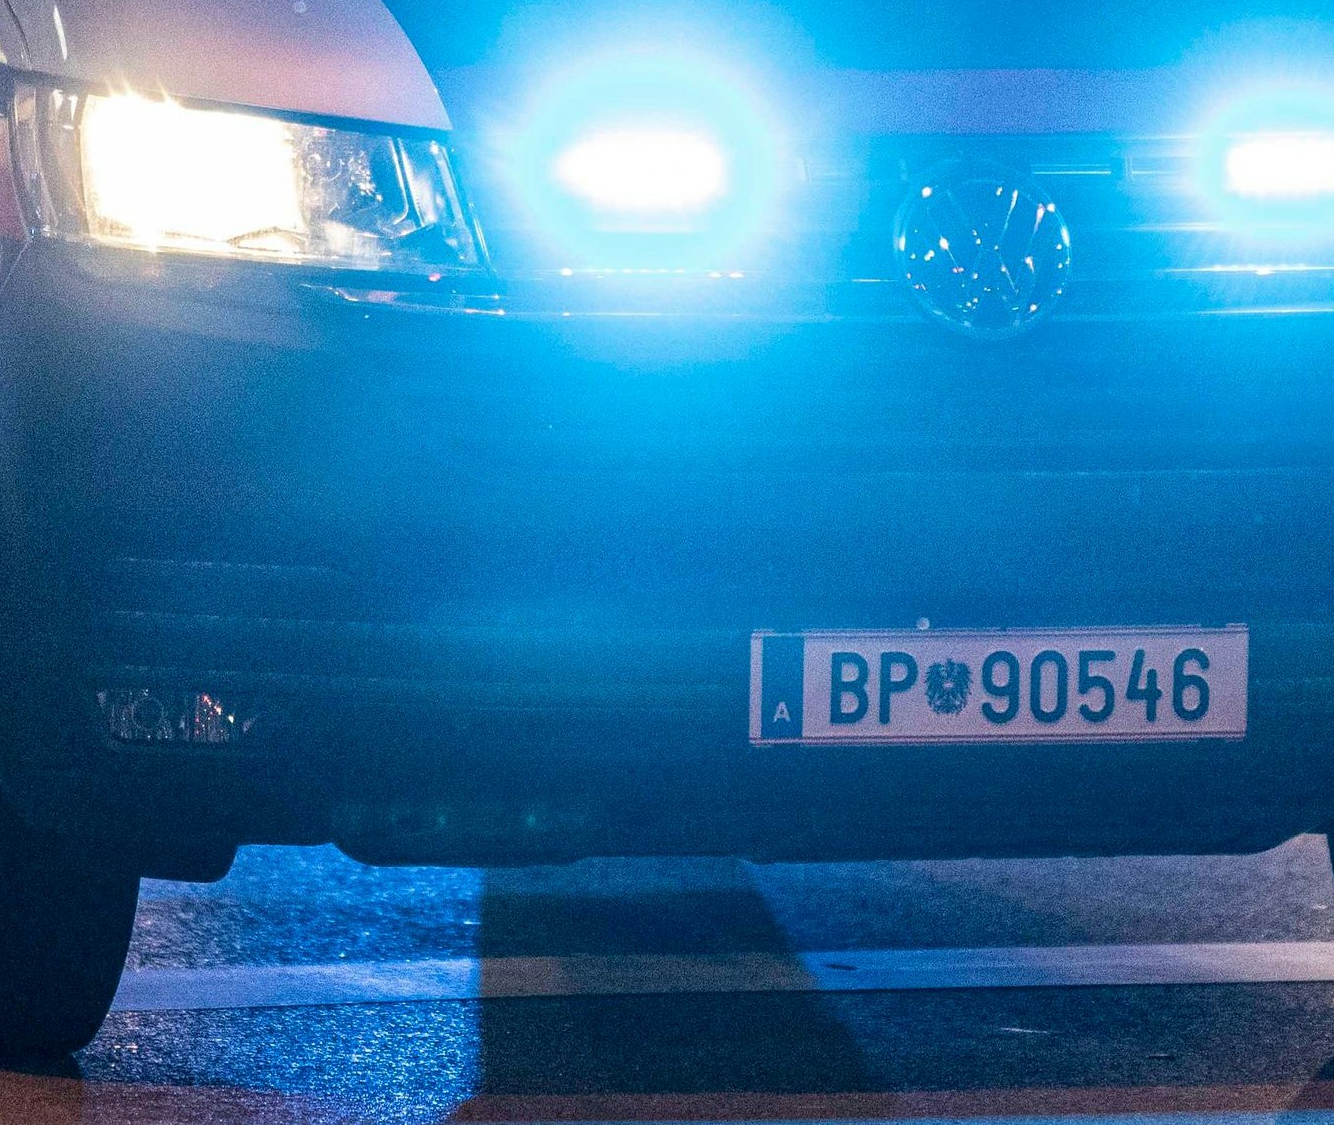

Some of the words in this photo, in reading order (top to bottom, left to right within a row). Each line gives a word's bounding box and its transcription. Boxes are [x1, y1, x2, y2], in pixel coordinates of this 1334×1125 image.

[771, 701, 792, 724] A
[828, 649, 920, 725] BP
[980, 647, 1212, 724] 90546
